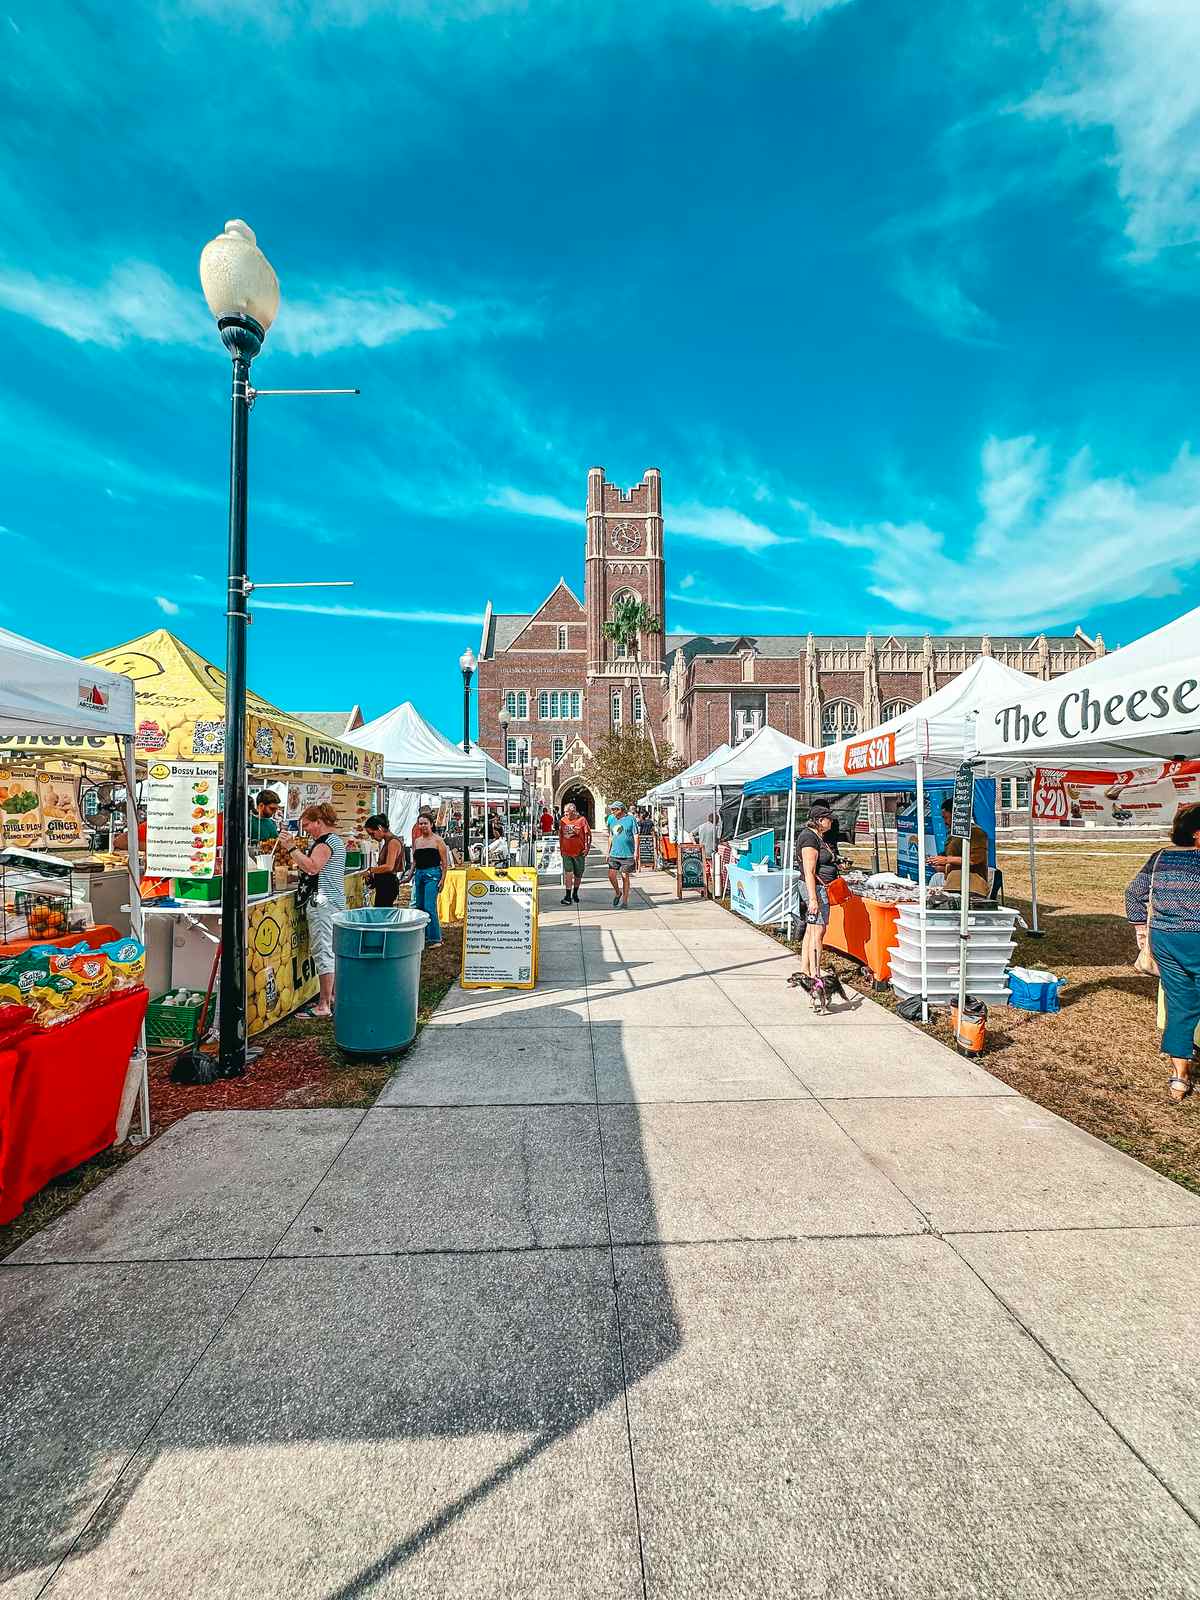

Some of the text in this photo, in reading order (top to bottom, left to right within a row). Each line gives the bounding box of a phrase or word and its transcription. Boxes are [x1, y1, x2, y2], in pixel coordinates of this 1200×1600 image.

[994, 679, 1200, 743] The Cheese
[305, 736, 359, 772] Lemonade
[869, 736, 890, 768] $20
[196, 767, 217, 775] LEMON
[1035, 788, 1066, 817] $20
[48, 821, 77, 831] GINGER
